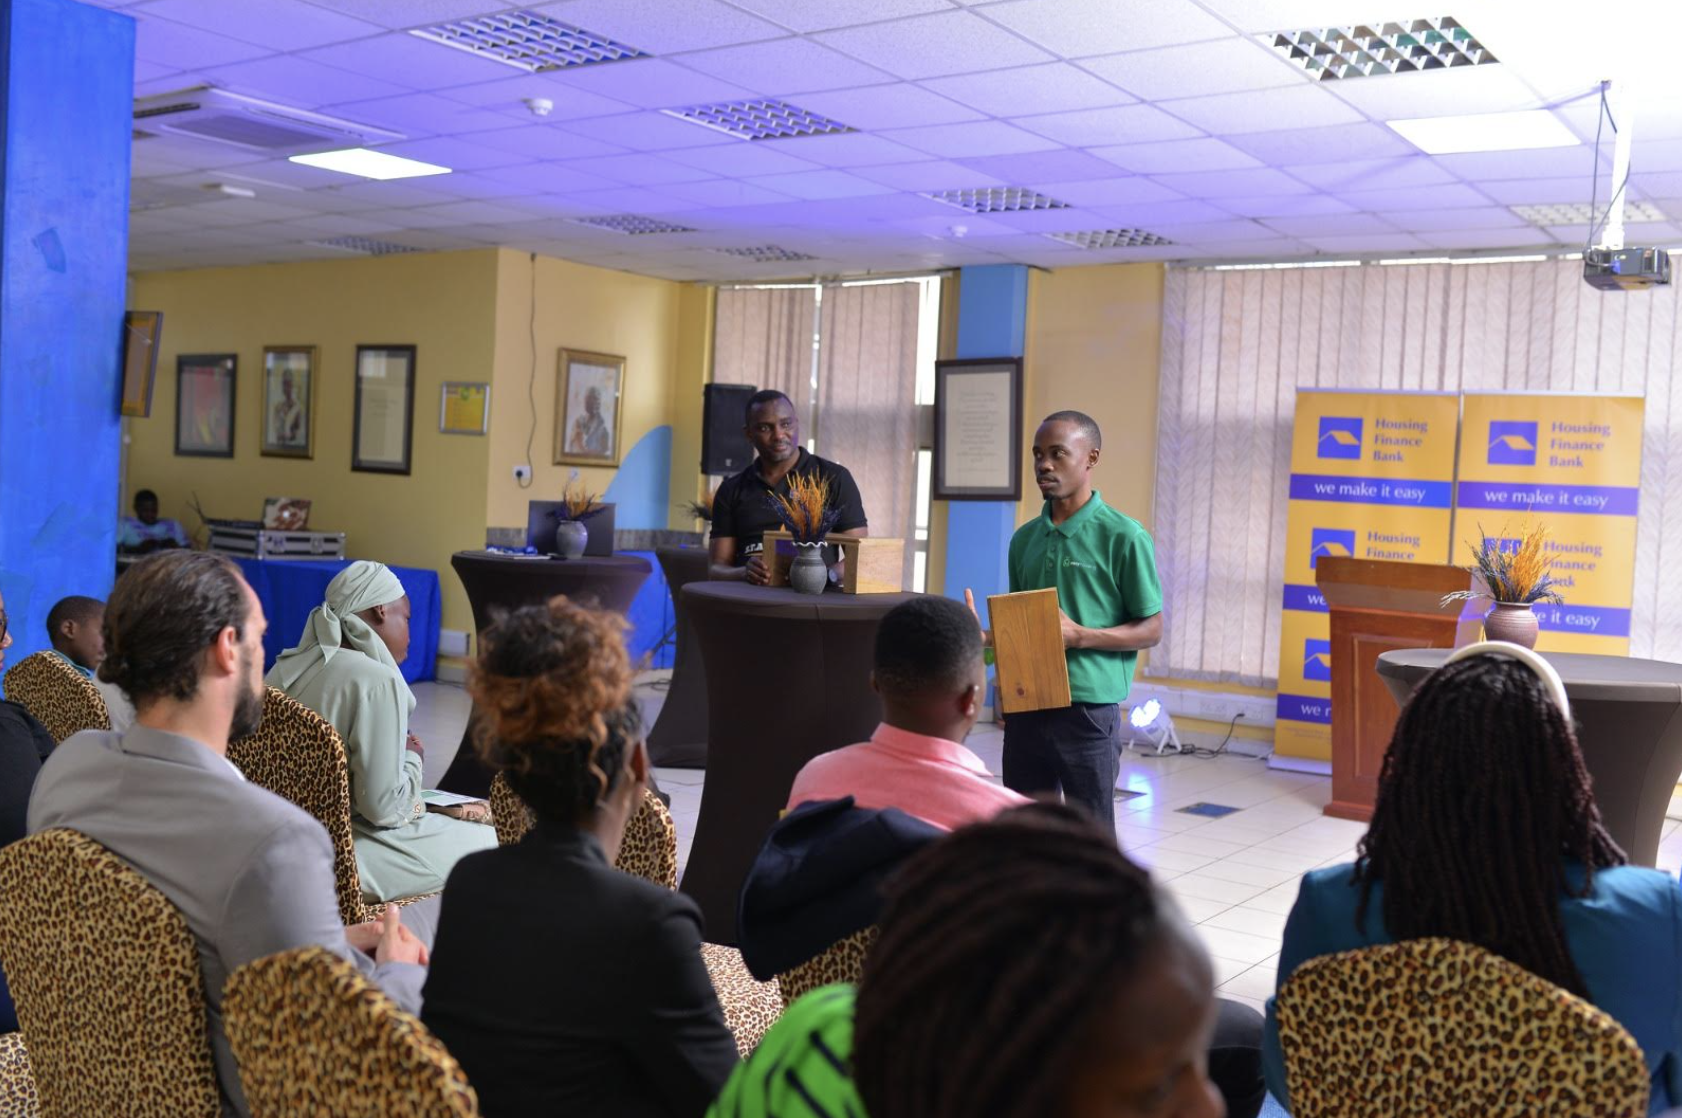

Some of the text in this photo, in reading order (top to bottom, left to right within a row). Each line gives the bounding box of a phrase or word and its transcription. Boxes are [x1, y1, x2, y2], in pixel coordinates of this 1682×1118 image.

[1375, 418, 1428, 433] Housing
[1551, 422, 1611, 437] Housing
[1374, 434, 1422, 446] Finance
[1550, 439, 1604, 451] Finance
[1373, 450, 1404, 462] Bank
[1549, 455, 1583, 467] Bank
[1315, 482, 1426, 503] we make it easy
[1485, 489, 1609, 510] we make it easy
[1367, 531, 1420, 548] Housing
[1366, 546, 1415, 559] Finance
[1544, 541, 1603, 558] Housing
[1551, 610, 1560, 624] it
[1565, 614, 1600, 630] easy
[1301, 704, 1321, 716] we
